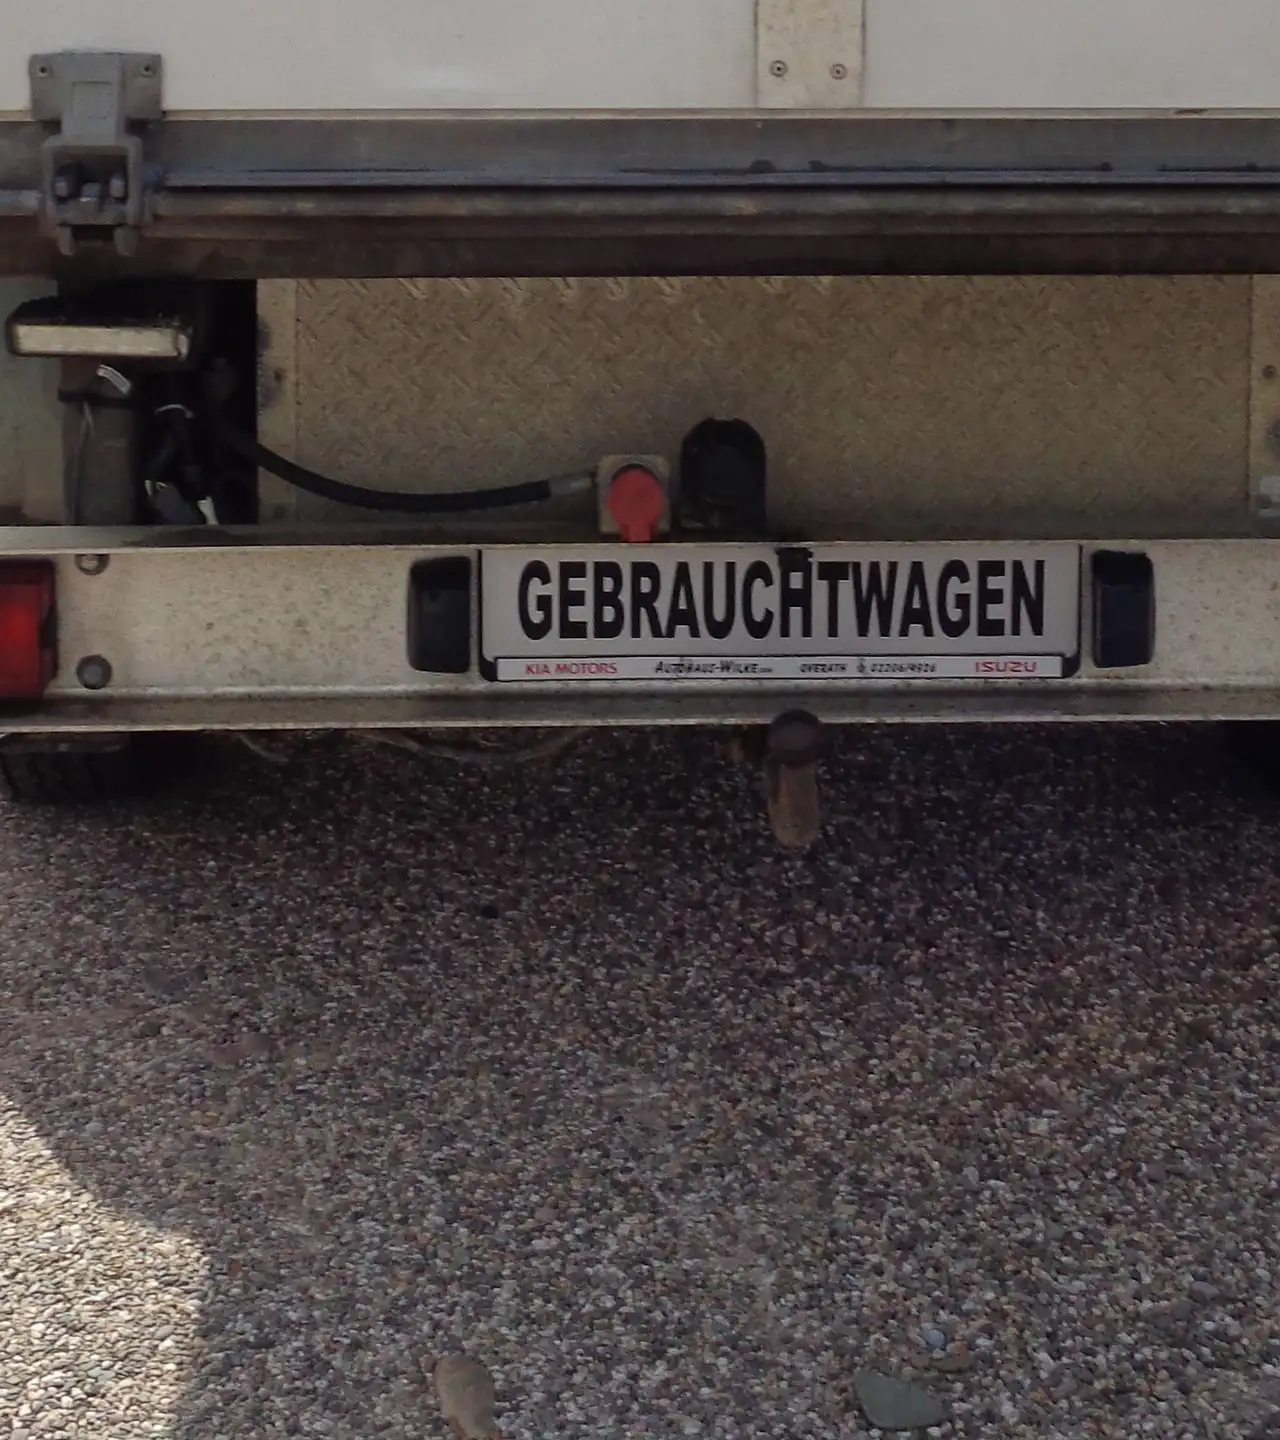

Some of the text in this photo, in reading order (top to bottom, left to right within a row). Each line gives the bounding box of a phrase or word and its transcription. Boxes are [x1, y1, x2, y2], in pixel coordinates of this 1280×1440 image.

[518, 559, 1044, 640] GEBRAUCHTWAGEN
[525, 662, 618, 675] KIA MOTORS
[975, 661, 1038, 673] ISUZU
